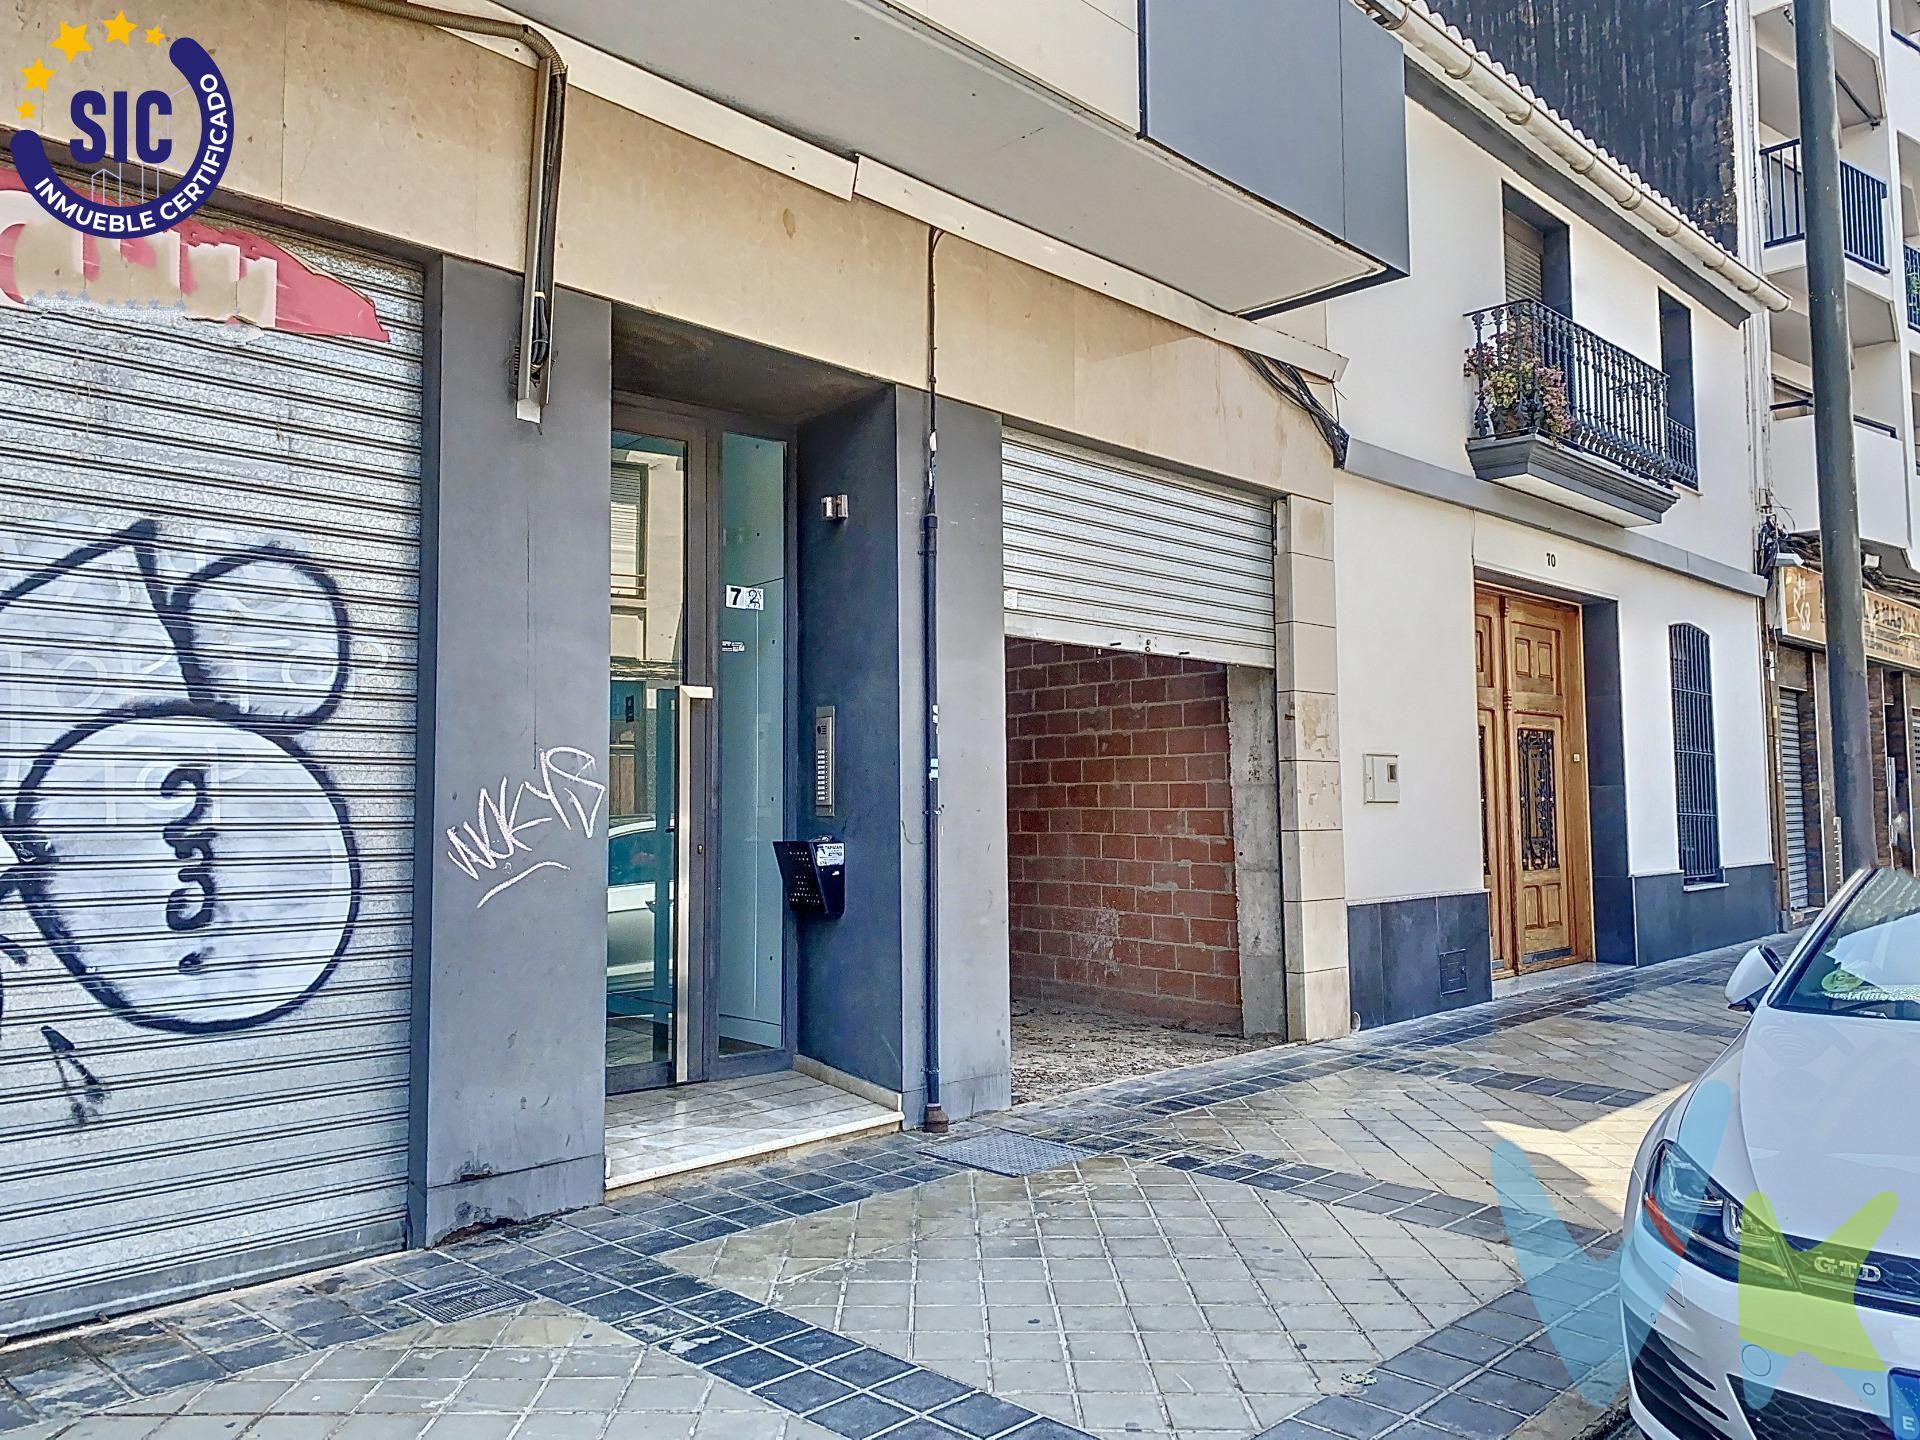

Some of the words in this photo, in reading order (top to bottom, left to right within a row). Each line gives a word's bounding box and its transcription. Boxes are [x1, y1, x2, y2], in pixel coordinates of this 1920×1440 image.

[1546, 552, 1556, 568] 70
[1814, 1256, 1881, 1282] GTD
[1902, 1415, 1915, 1432] E
